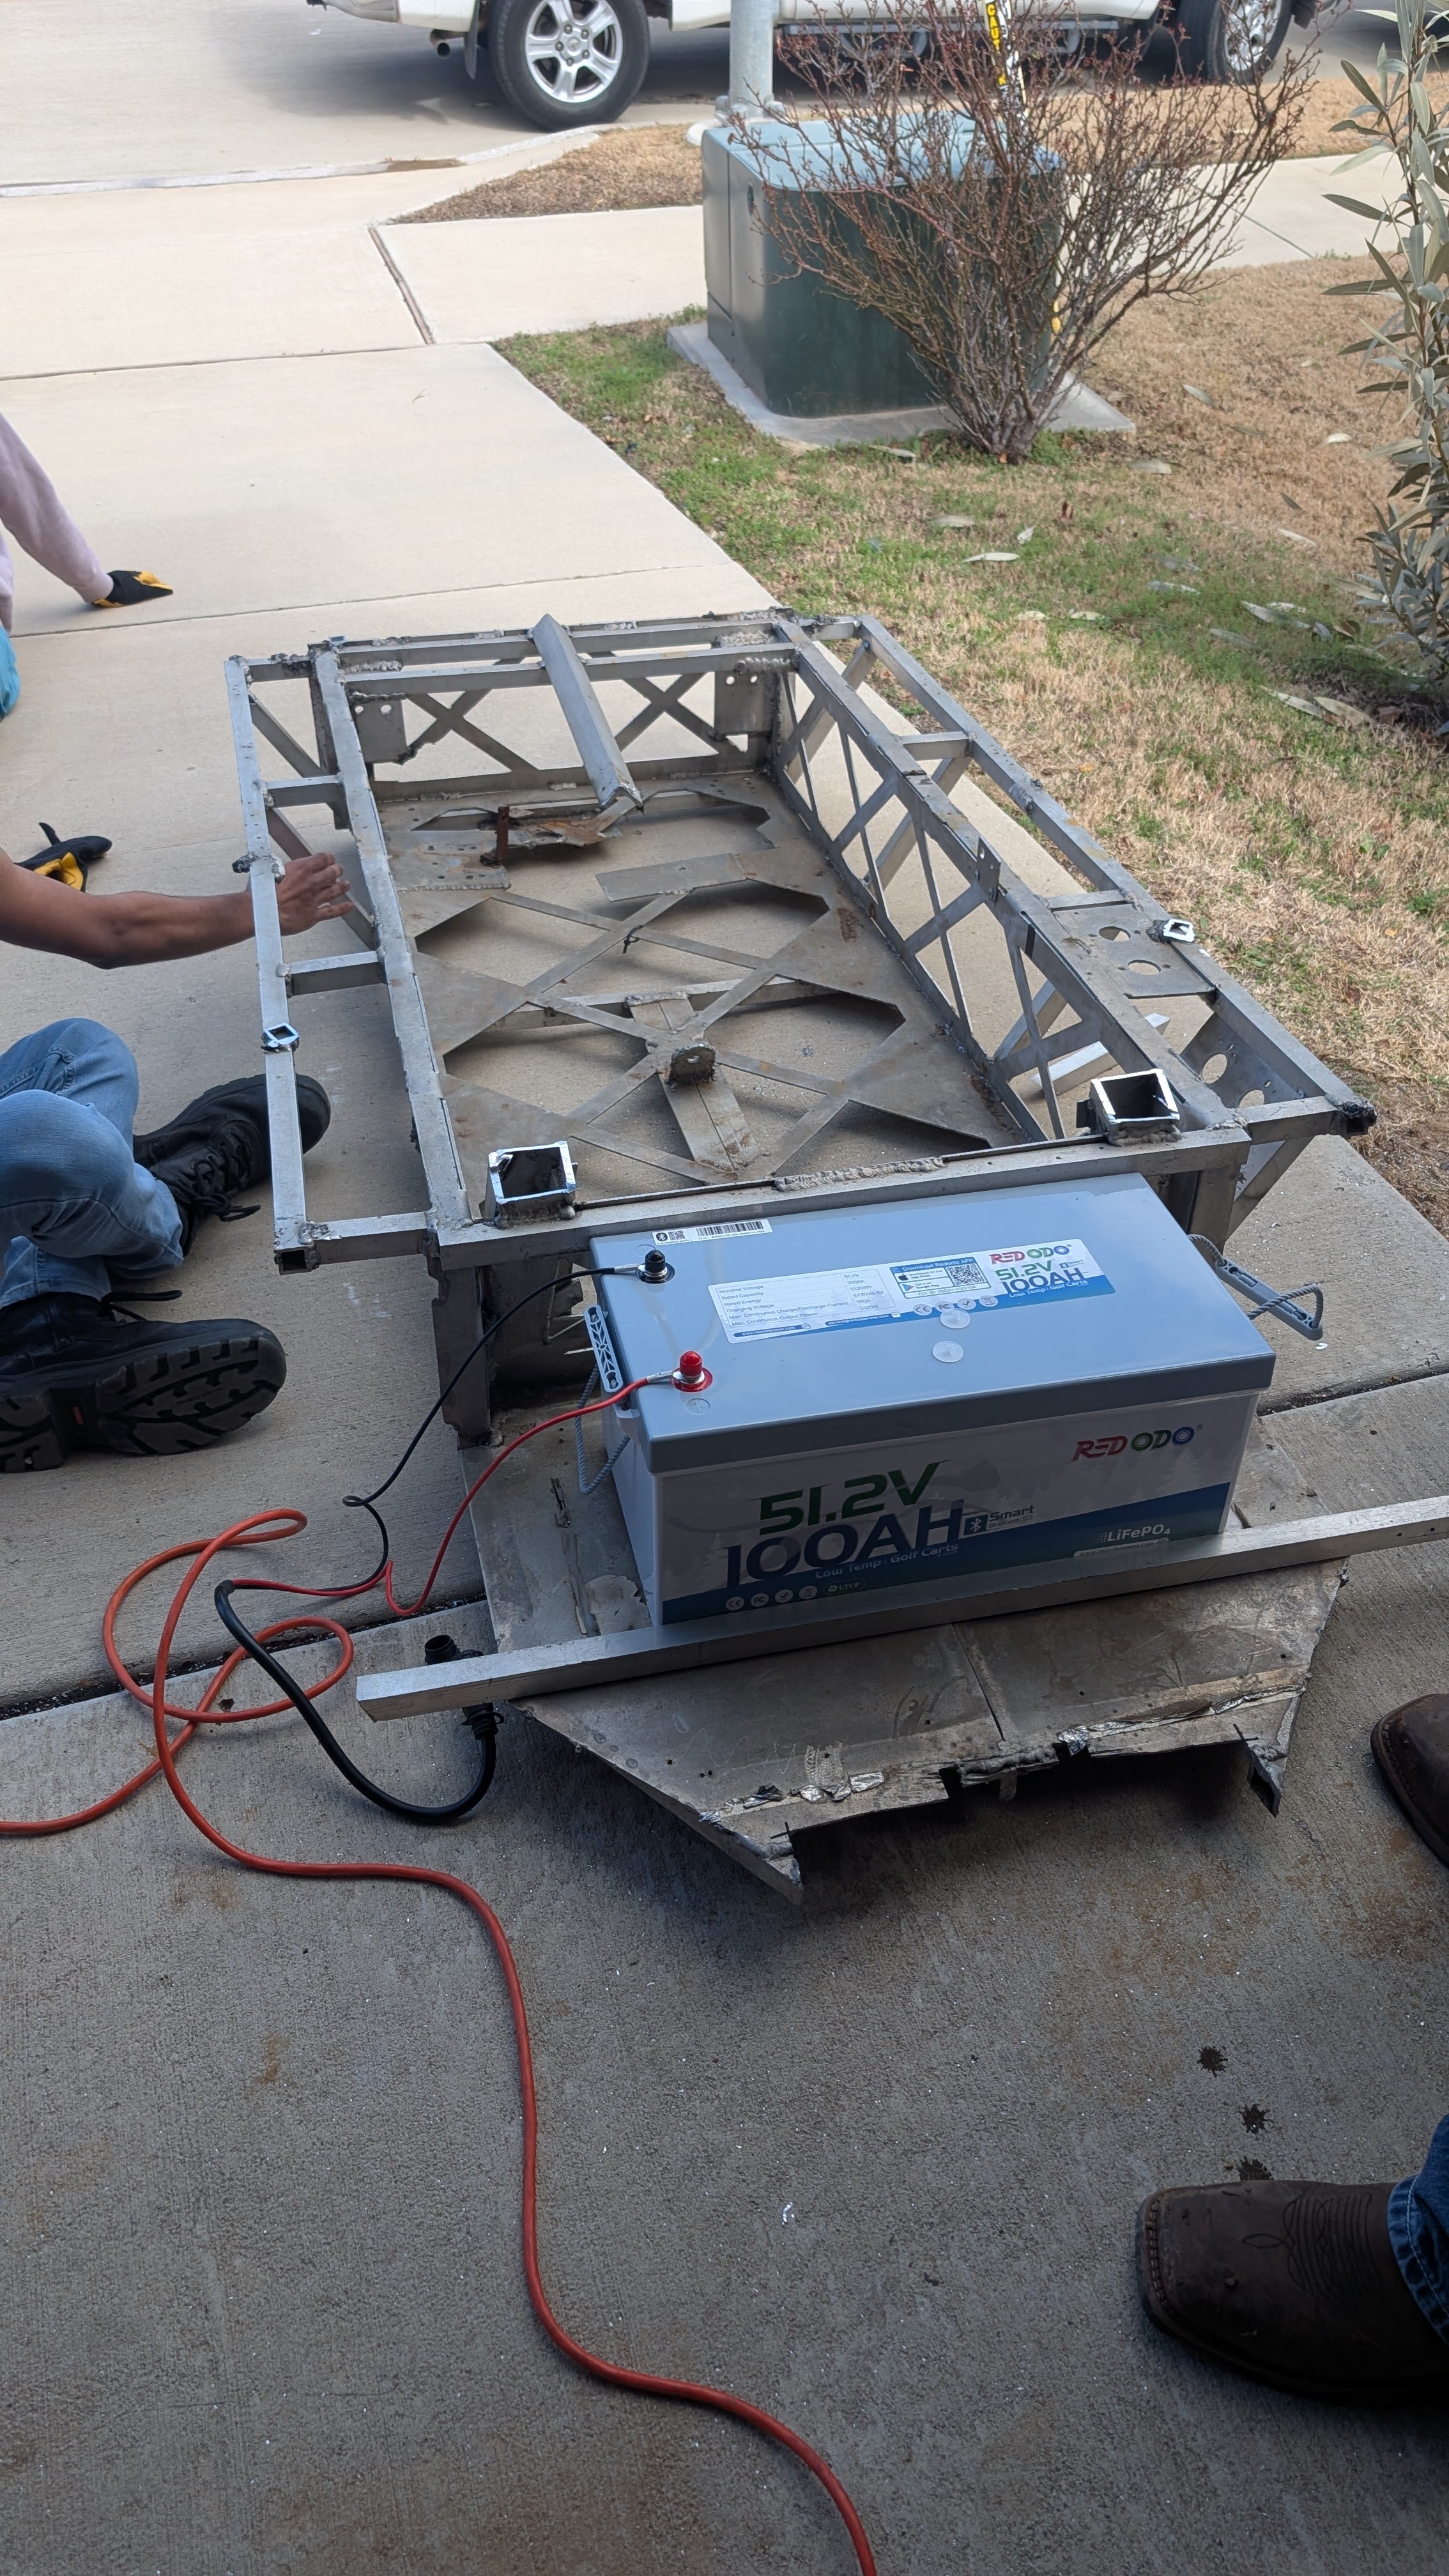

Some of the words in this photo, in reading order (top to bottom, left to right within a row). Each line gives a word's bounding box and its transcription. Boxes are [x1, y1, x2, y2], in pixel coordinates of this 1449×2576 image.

[989, 1245, 1070, 1264] REDODO
[994, 1260, 1054, 1280] 51.2V
[1002, 1268, 1086, 1294] 100AH
[776, 1305, 826, 1314] Charge/Discharge
[1071, 1426, 1195, 1462] REDODO
[758, 1460, 950, 1535] 51.2V
[988, 1518, 1020, 1528] Bluetooth
[989, 1505, 1034, 1521] Smart
[727, 1499, 963, 1589] 100AH
[816, 1567, 843, 1579] Low
[848, 1560, 882, 1573] Temp
[891, 1551, 917, 1563] Golf
[921, 1543, 959, 1557] Carts
